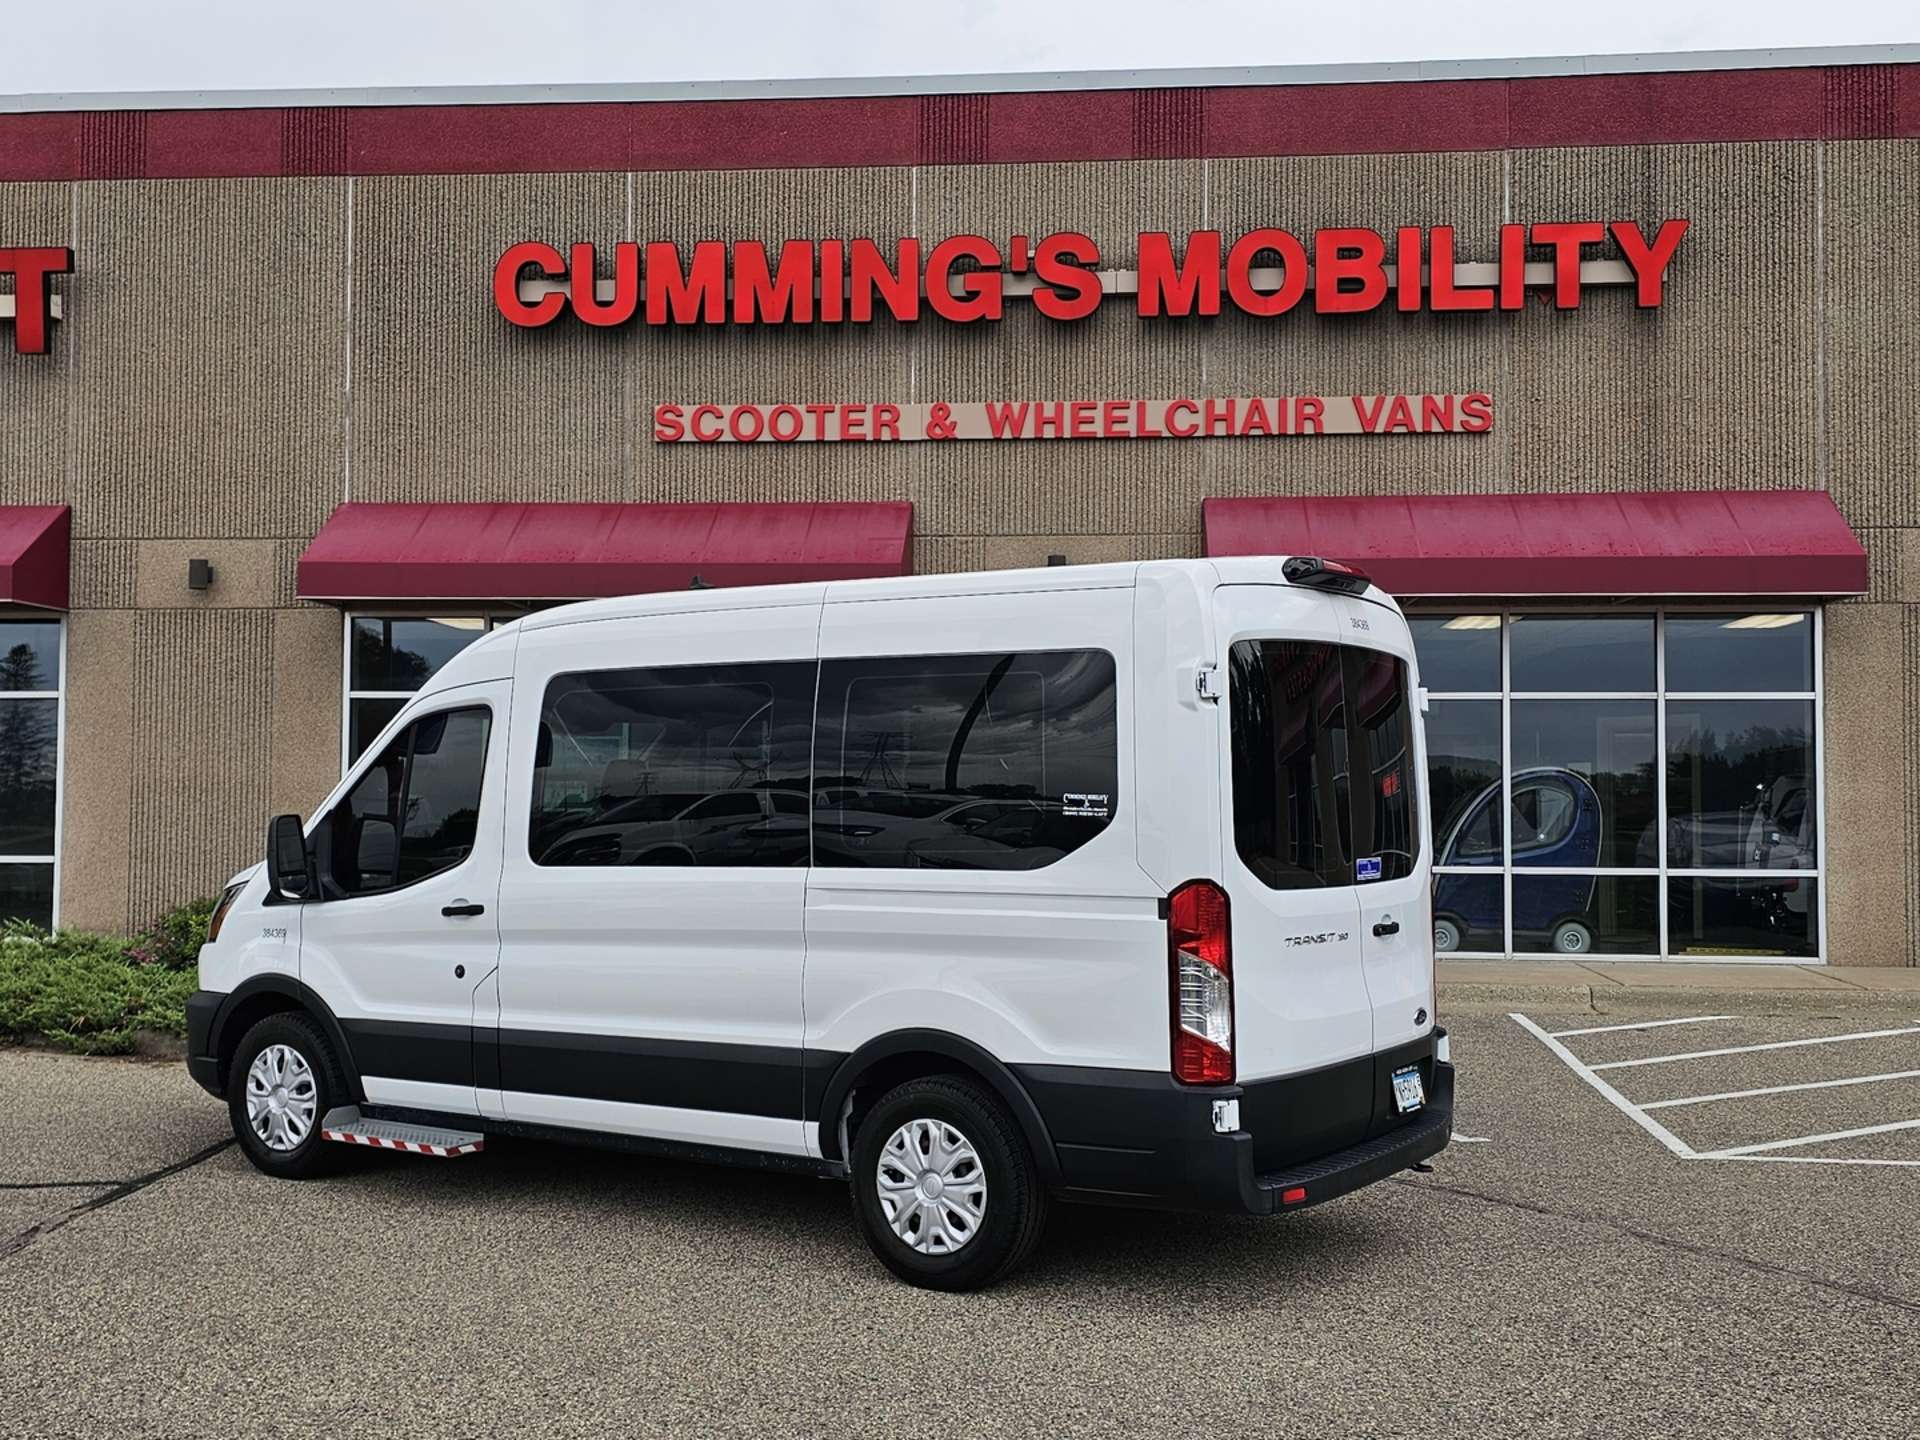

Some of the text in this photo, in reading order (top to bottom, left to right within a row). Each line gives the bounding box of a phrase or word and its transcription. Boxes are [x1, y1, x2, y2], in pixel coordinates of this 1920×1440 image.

[492, 219, 1690, 328] CUMMING'S MOBILITY
[655, 391, 1494, 442] SCOOTER & WHEELCHAIR VANS
[1284, 932, 1336, 948] TRANSIT
